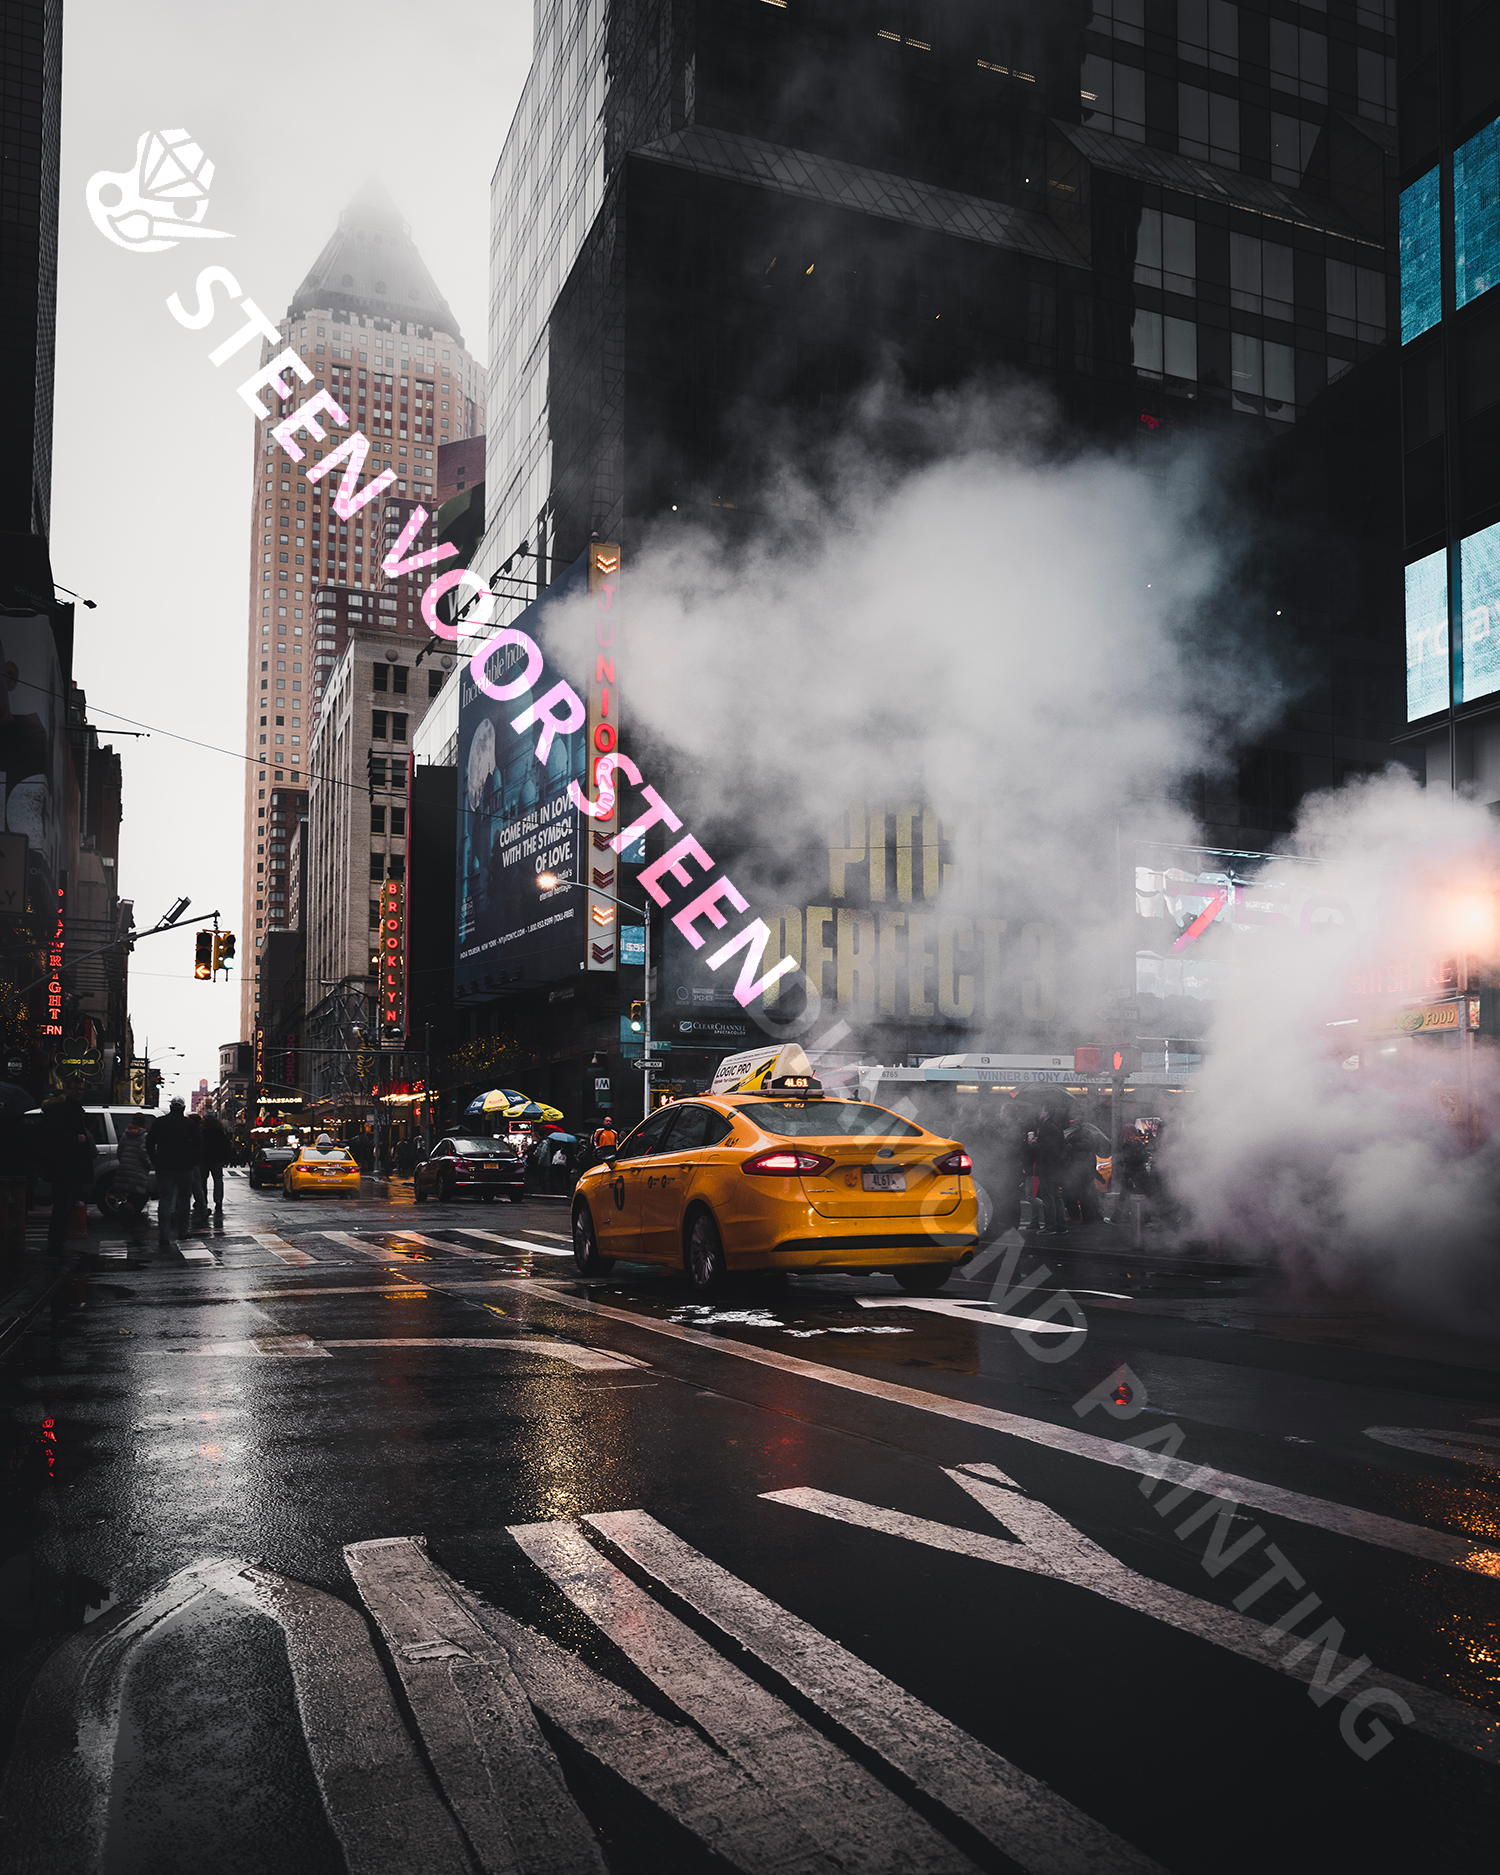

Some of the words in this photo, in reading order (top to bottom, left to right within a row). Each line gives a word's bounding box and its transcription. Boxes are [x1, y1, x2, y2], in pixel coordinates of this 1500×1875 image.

[500, 820, 521, 847] COME
[522, 811, 539, 835] FALL
[540, 804, 550, 824] IN
[552, 792, 574, 819] LOVE
[502, 843, 521, 868] WITH
[523, 835, 537, 857] THE
[538, 816, 573, 850] SYMBOL
[535, 852, 547, 874] OF
[548, 841, 573, 868] LOVE.
[385, 883, 399, 1021] BROOKLYN
[762, 903, 1008, 1021] PERFECT
[1020, 921, 1056, 1022] 3
[1425, 1009, 1456, 1026] FOOD
[715, 1064, 738, 1078] LOGIC
[736, 1062, 752, 1076] PRO
[784, 1077, 809, 1087] 4L61
[881, 1070, 898, 1079] 6765
[977, 1070, 1021, 1081] WINNER
[1023, 1071, 1030, 1081] 6
[1031, 1071, 1060, 1082] TONY
[1062, 1072, 1108, 1083] AWARDS
